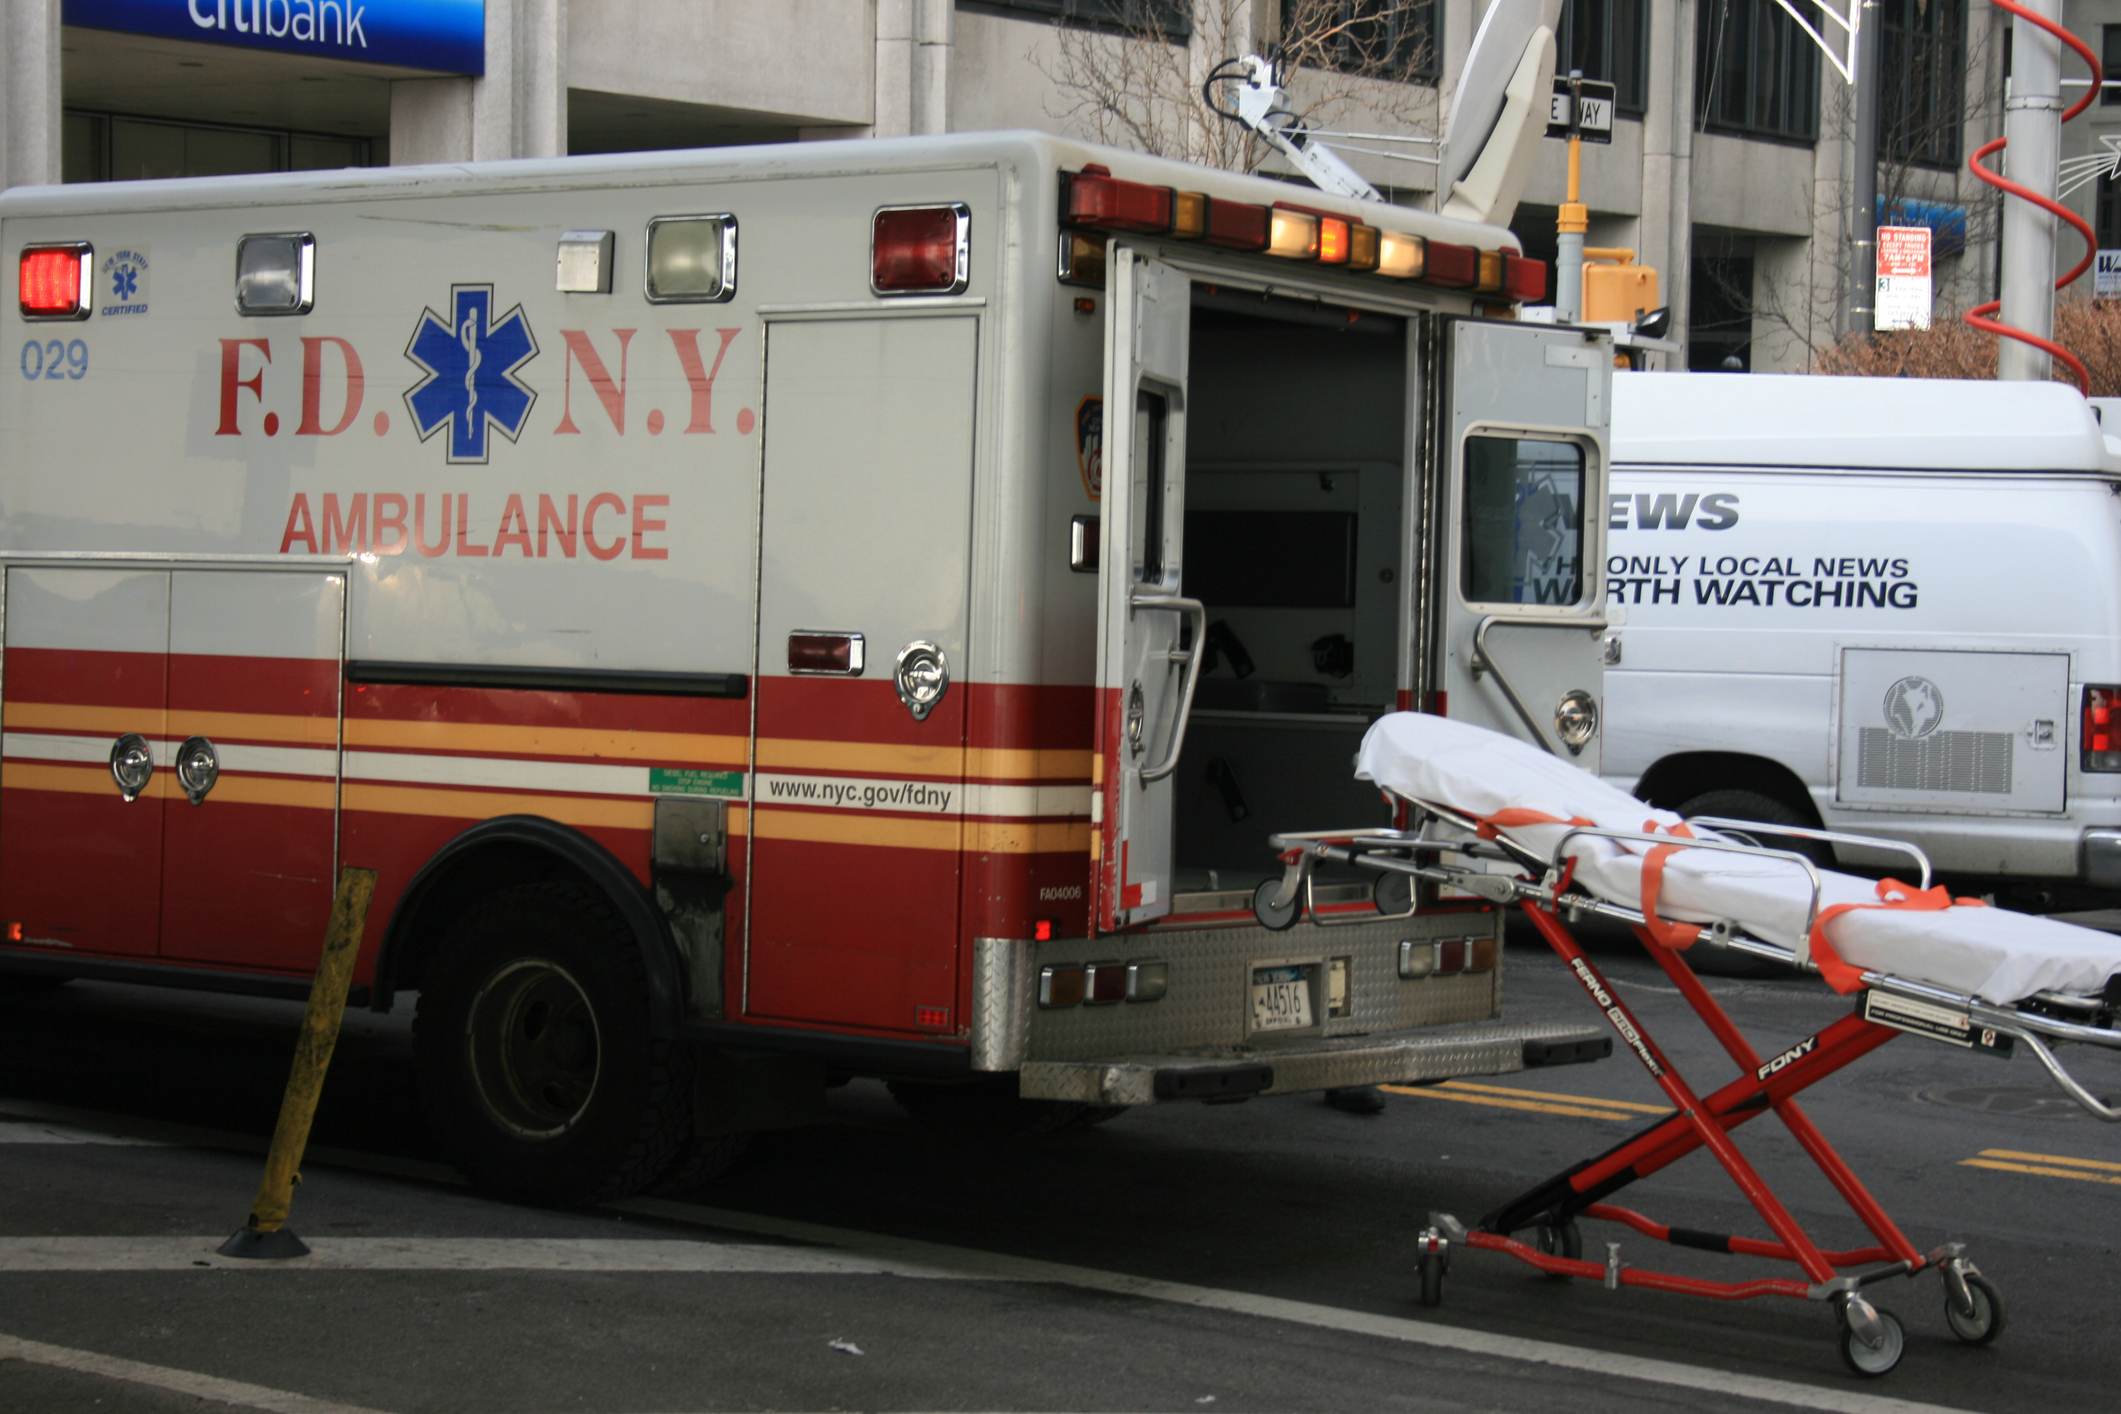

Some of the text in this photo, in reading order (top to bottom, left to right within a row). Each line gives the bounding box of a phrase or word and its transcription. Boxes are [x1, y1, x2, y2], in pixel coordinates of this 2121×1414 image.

[1881, 232, 1927, 243] NO STANDING
[102, 304, 148, 316] CERTIFIED
[20, 339, 89, 380] 029
[279, 492, 671, 561] AMBULANCE
[1607, 556, 1910, 579] ONLY LOCAL NEWS
[1693, 578, 1919, 610] WATCHING
[770, 780, 952, 812] www.nyc.gov/fdny
[1040, 886, 1081, 901] FA04006
[1571, 957, 1612, 1007] FERNO
[1758, 1036, 1815, 1081] FDNY
